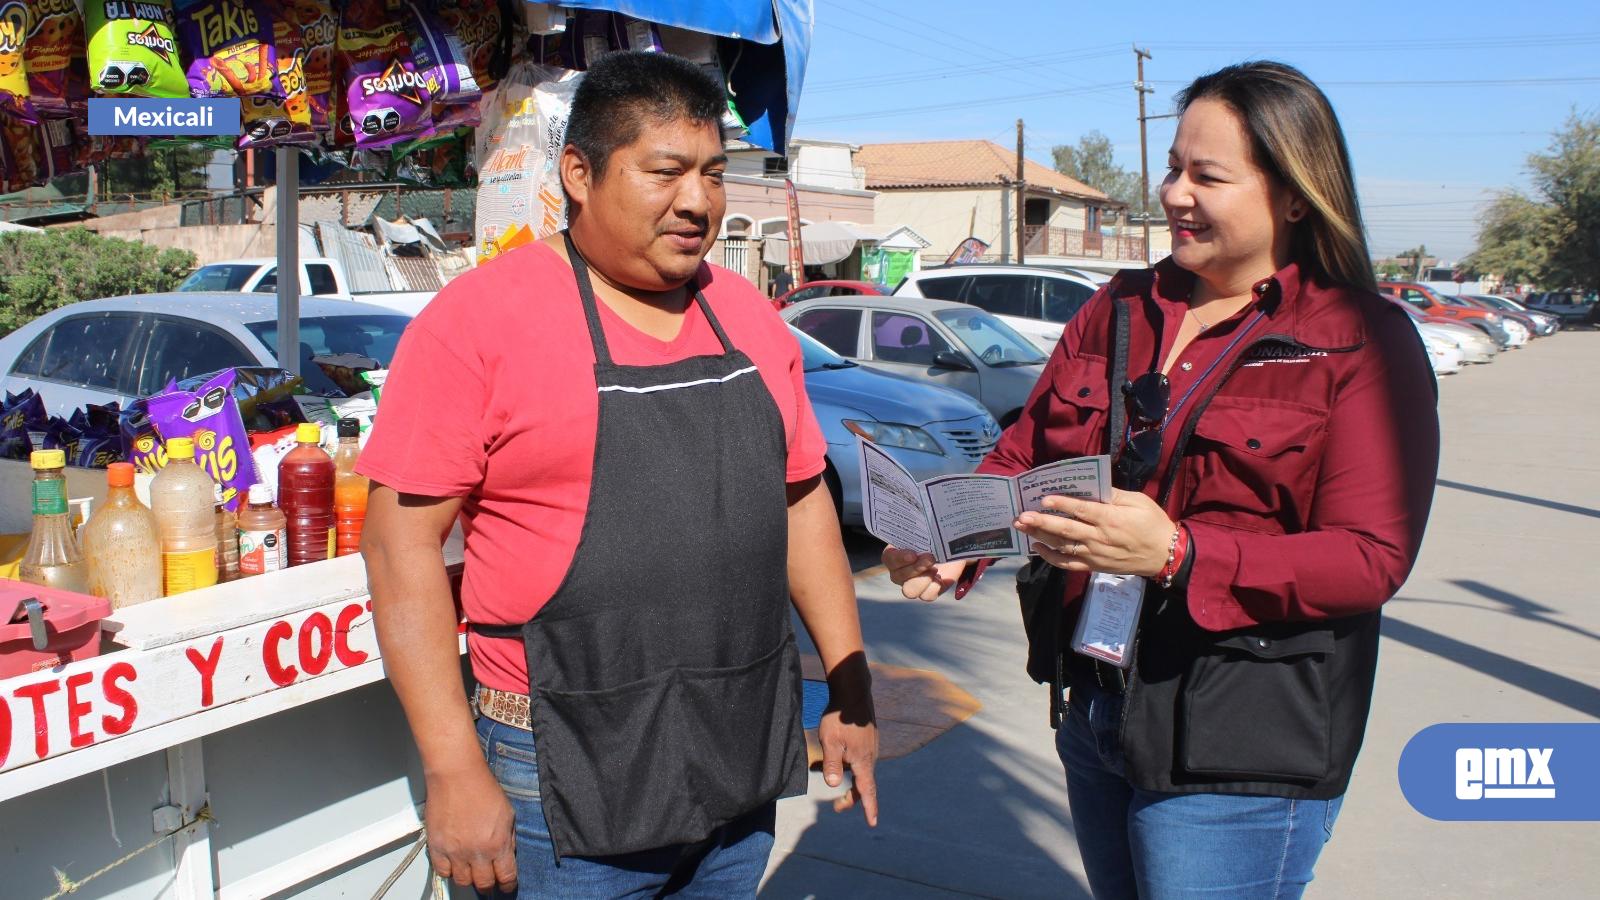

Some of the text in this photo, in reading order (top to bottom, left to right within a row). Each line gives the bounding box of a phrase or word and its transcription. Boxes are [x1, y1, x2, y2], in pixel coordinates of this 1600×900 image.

[191, 1, 259, 56] Takis
[128, 32, 174, 54] Doritos
[363, 70, 427, 96] Doritos
[1022, 474, 1097, 491] SERVICIOS
[1041, 483, 1078, 493] PARA
[186, 636, 225, 707] Y
[263, 600, 373, 687] COC
